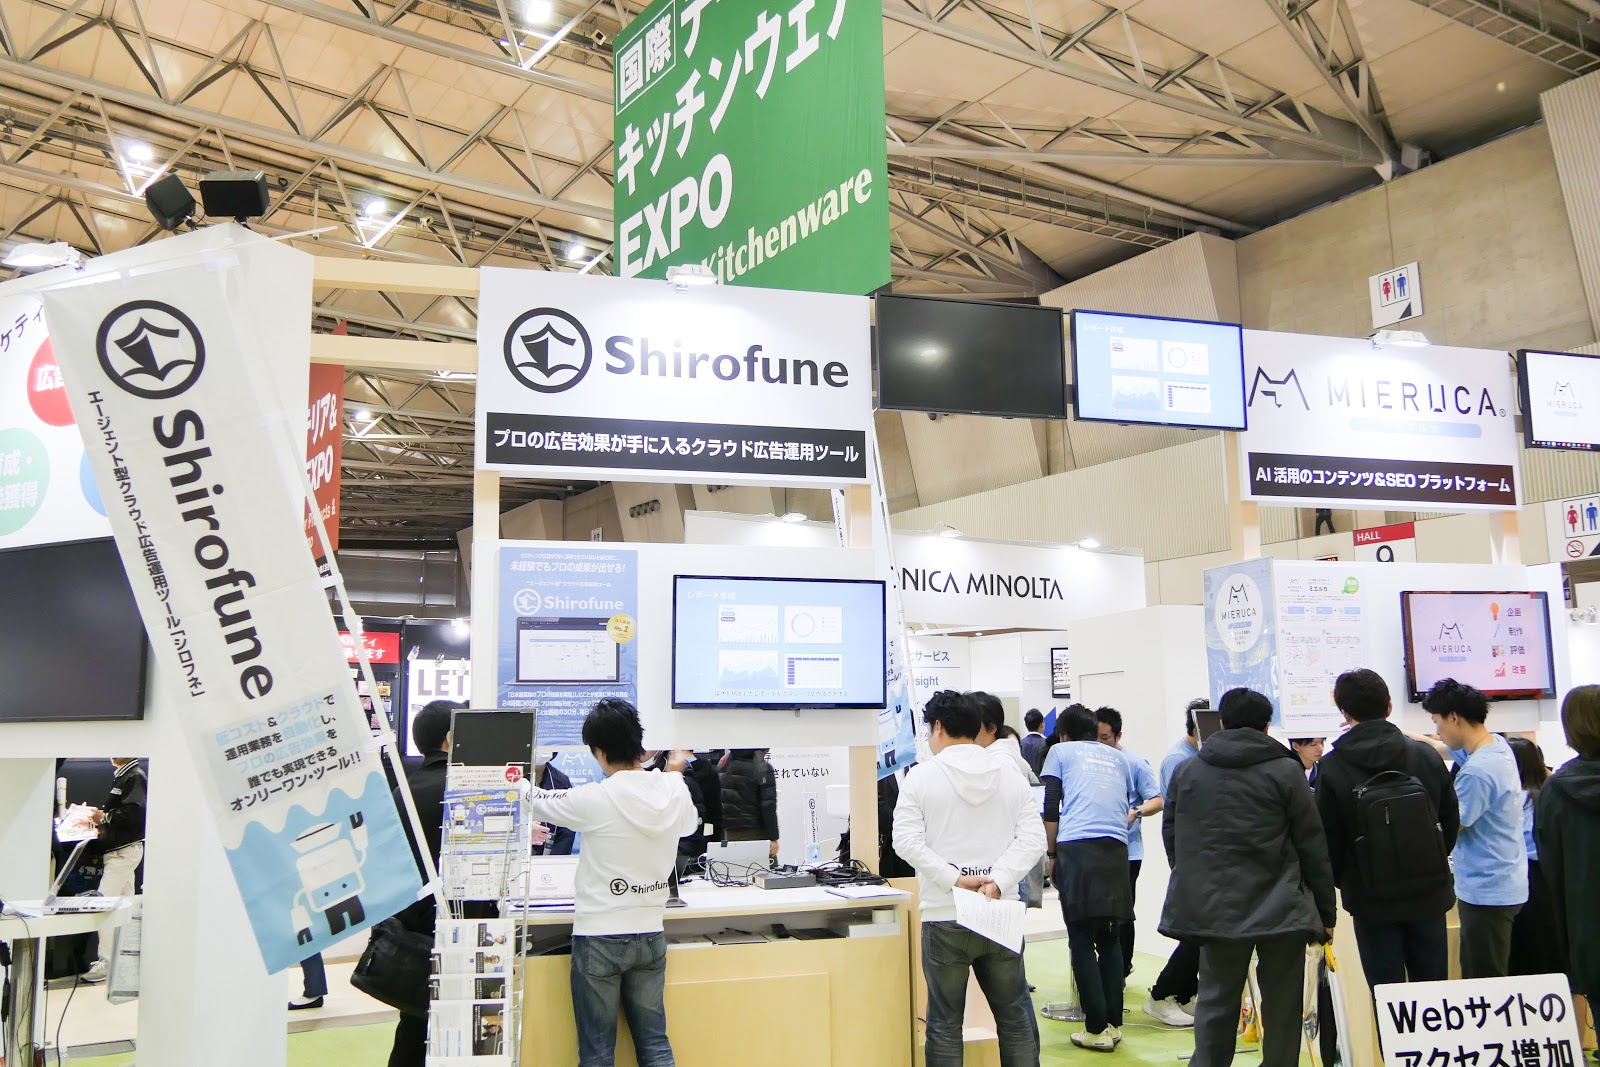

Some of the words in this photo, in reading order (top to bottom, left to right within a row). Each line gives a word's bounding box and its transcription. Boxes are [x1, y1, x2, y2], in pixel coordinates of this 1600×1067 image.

[620, 13, 672, 104] 国際
[620, 154, 733, 278] EXPO
[604, 334, 850, 388] Shirofune
[1326, 375, 1498, 417] MIERUCA
[493, 428, 860, 464] プロの広告効果が手に入るクラウド広告運用ツール
[87, 390, 206, 698] エージェント型クラウド広告運用ツール「シロフネ」
[1357, 531, 1381, 542] HALL
[152, 408, 275, 701] Shirofune
[898, 566, 960, 594] NICA
[966, 571, 1064, 601] MINOLTA
[544, 595, 624, 610] Shirofune
[687, 591, 737, 601] レポート作成
[1221, 607, 1257, 621] MIERUCA
[1507, 607, 1522, 617] 企画
[1430, 644, 1472, 653] MIERUCA
[1512, 665, 1527, 675] 改善
[905, 675, 939, 689] isight
[1075, 749, 1120, 764] MIERUCA
[247, 745, 338, 789] 誰でも実現できる
[961, 866, 993, 877] Shirof
[630, 880, 669, 894] Shirofun
[1387, 992, 1567, 1034] Webサイトの
